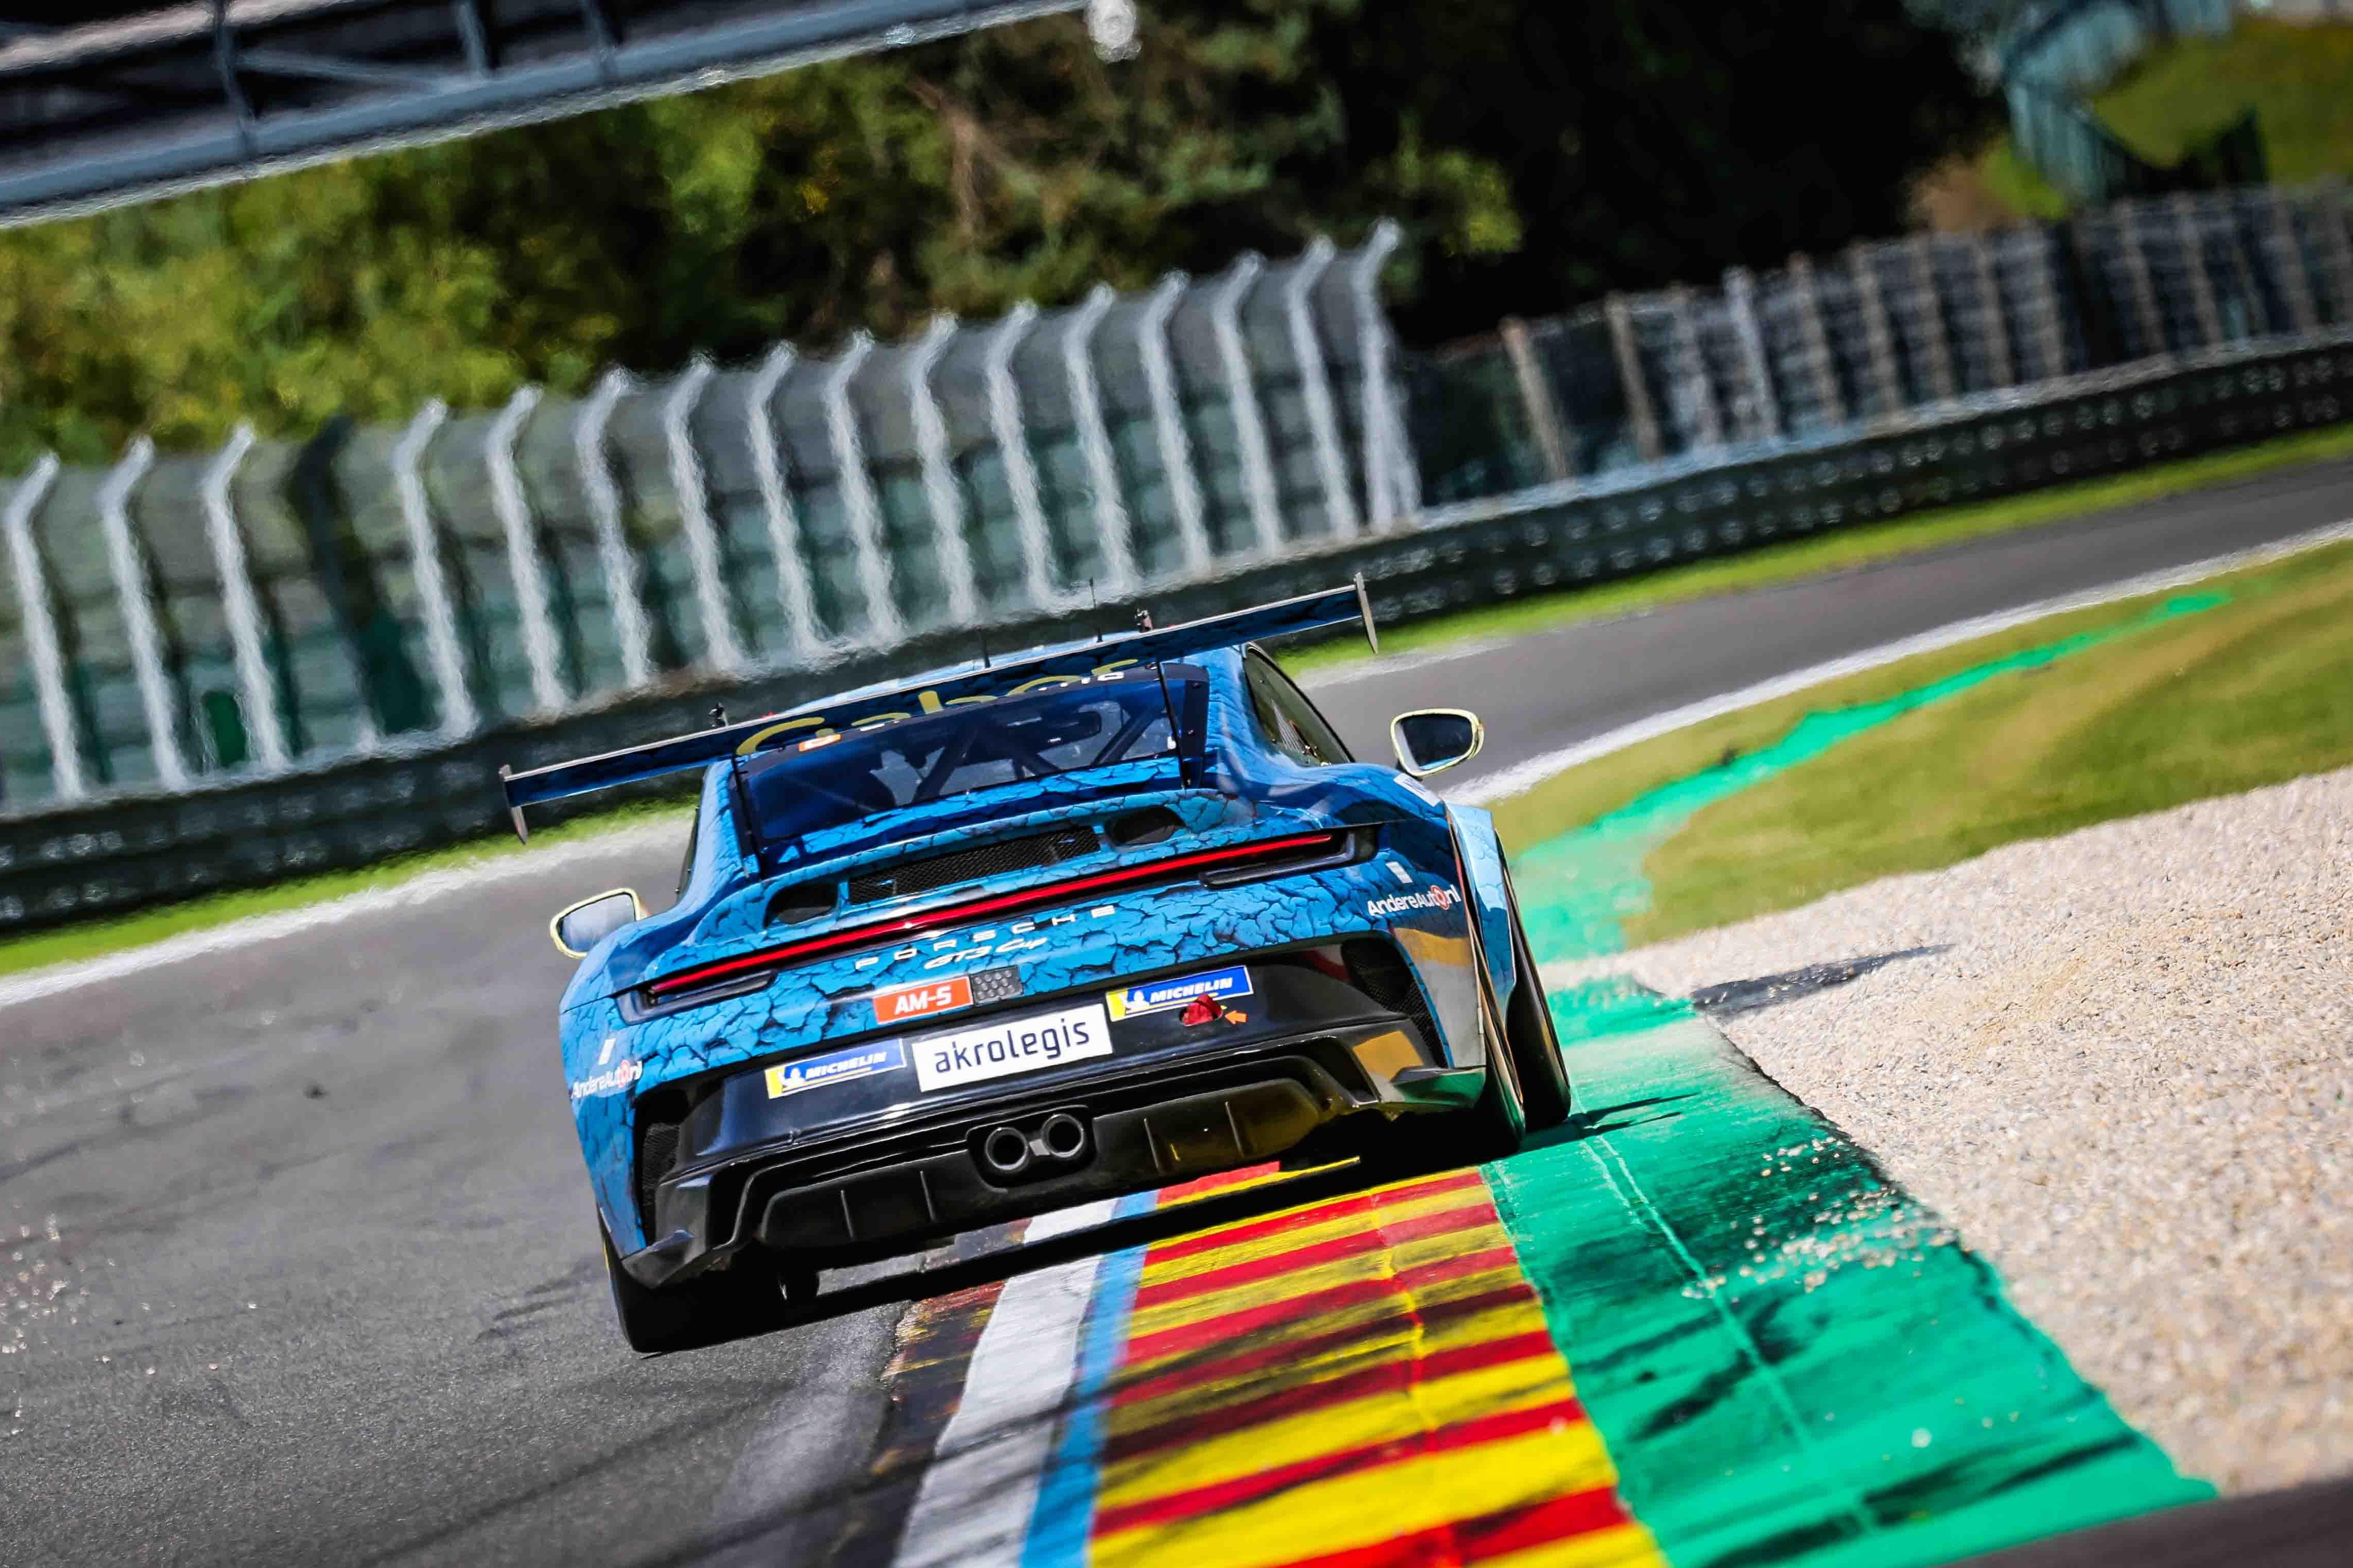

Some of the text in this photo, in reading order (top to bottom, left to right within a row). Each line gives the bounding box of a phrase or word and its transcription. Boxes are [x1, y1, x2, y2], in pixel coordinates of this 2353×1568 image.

[855, 905, 1115, 969] PORSCHE
[925, 937, 1047, 969] GT3 Cup
[1150, 977, 1233, 1003] MICHELIN
[934, 1019, 1089, 1073] akrolegis
[805, 1051, 887, 1080] MICHELIN
